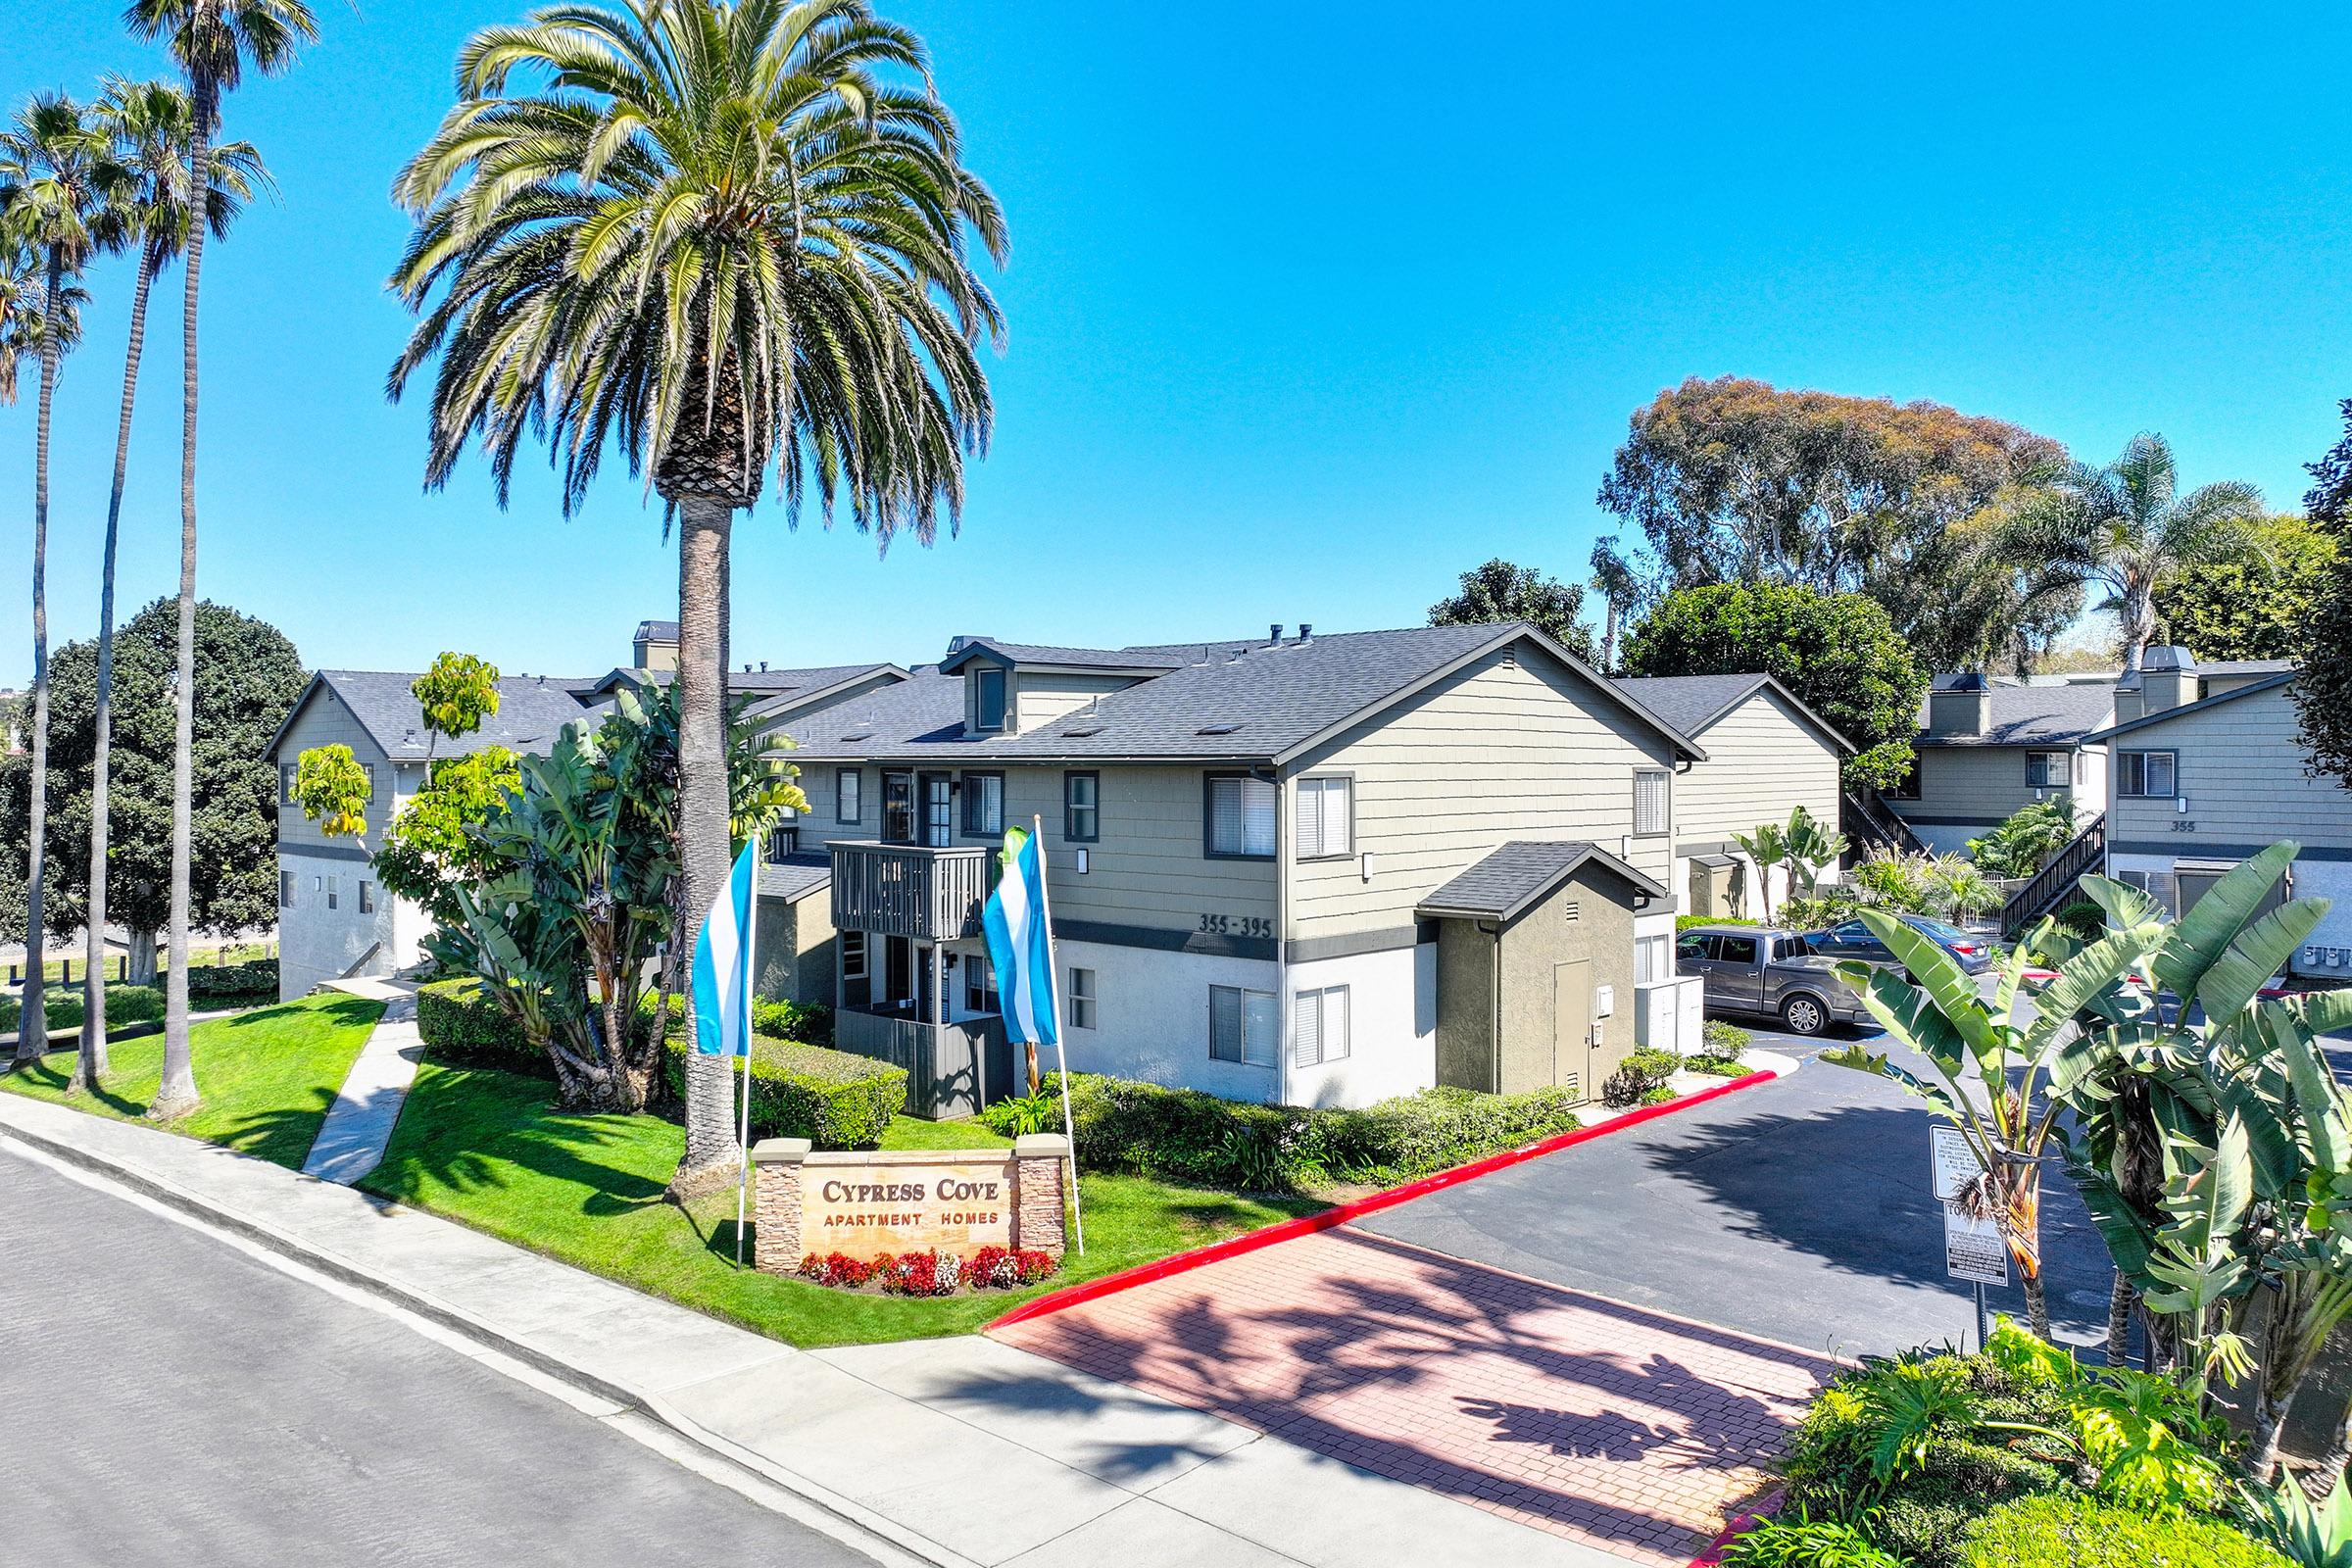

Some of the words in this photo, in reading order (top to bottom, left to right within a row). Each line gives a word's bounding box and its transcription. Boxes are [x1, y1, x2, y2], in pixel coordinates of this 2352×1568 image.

[2171, 820, 2195, 832] 355
[824, 1213, 921, 1227] APARTMENT
[941, 1212, 999, 1225] HOMES
